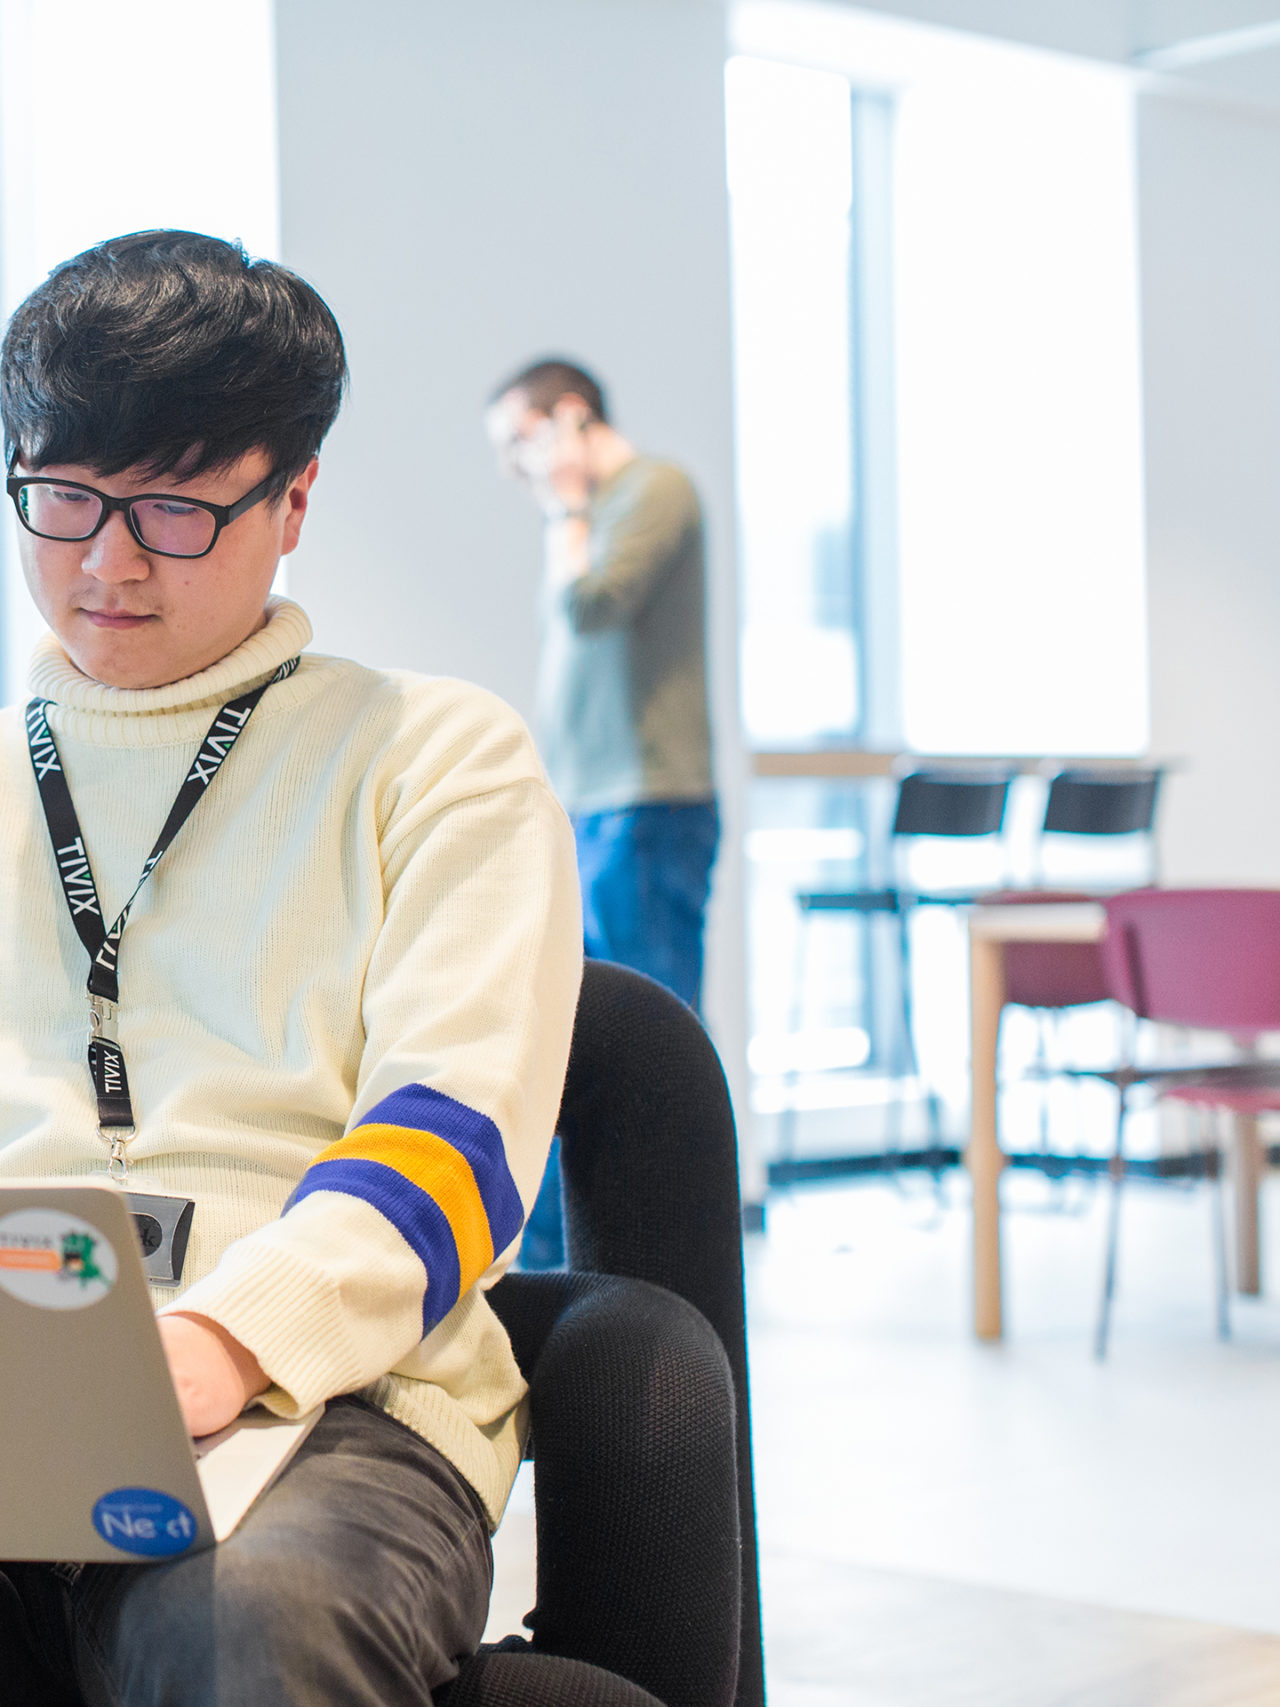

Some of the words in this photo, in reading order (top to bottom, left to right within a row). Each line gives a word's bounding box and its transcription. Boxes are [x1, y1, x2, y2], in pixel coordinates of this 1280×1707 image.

[26, 701, 62, 782] TIVIX
[186, 706, 252, 786] TIVIX
[56, 836, 100, 915] TIVIX
[103, 1049, 122, 1094] TIVIX
